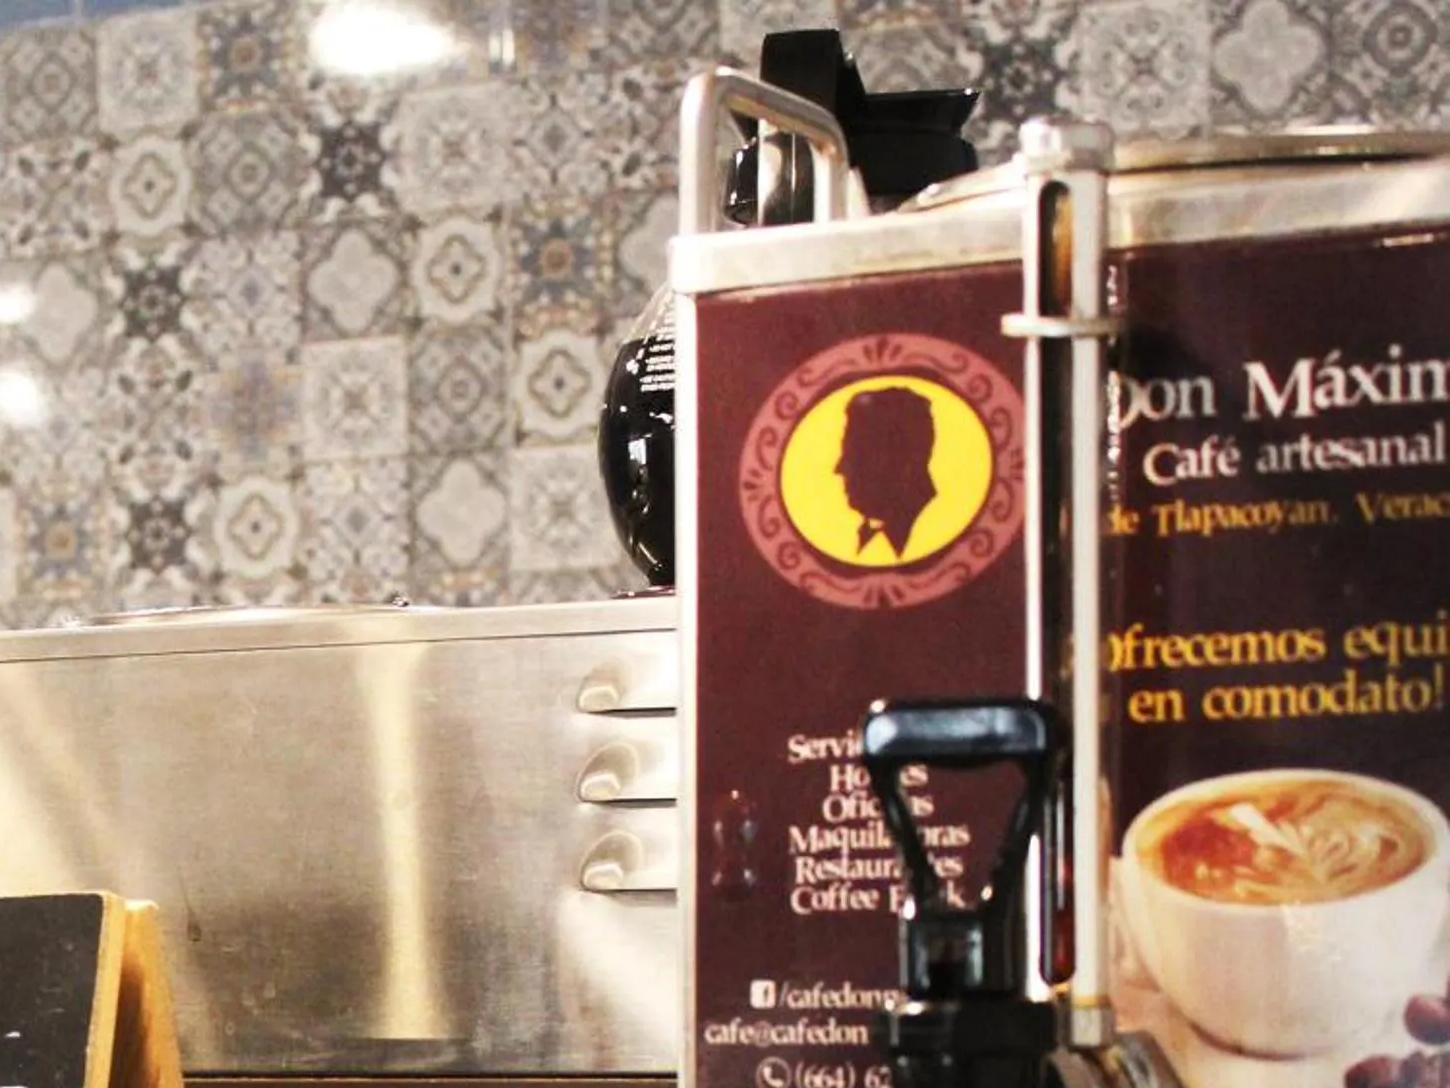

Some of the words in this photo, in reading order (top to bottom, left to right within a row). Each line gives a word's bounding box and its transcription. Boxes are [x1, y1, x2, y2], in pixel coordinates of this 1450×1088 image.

[1243, 344, 1450, 421] Máxim
[1143, 435, 1241, 486] Café
[1256, 420, 1445, 474] artesanal
[1356, 493, 1450, 525] Verac
[1343, 609, 1450, 669] equi
[1127, 687, 1185, 723] en
[1202, 662, 1443, 720] comodato!
[787, 730, 863, 764] Servi
[790, 881, 879, 915] Coffee
[704, 1017, 869, 1047] cafe@cafedon
